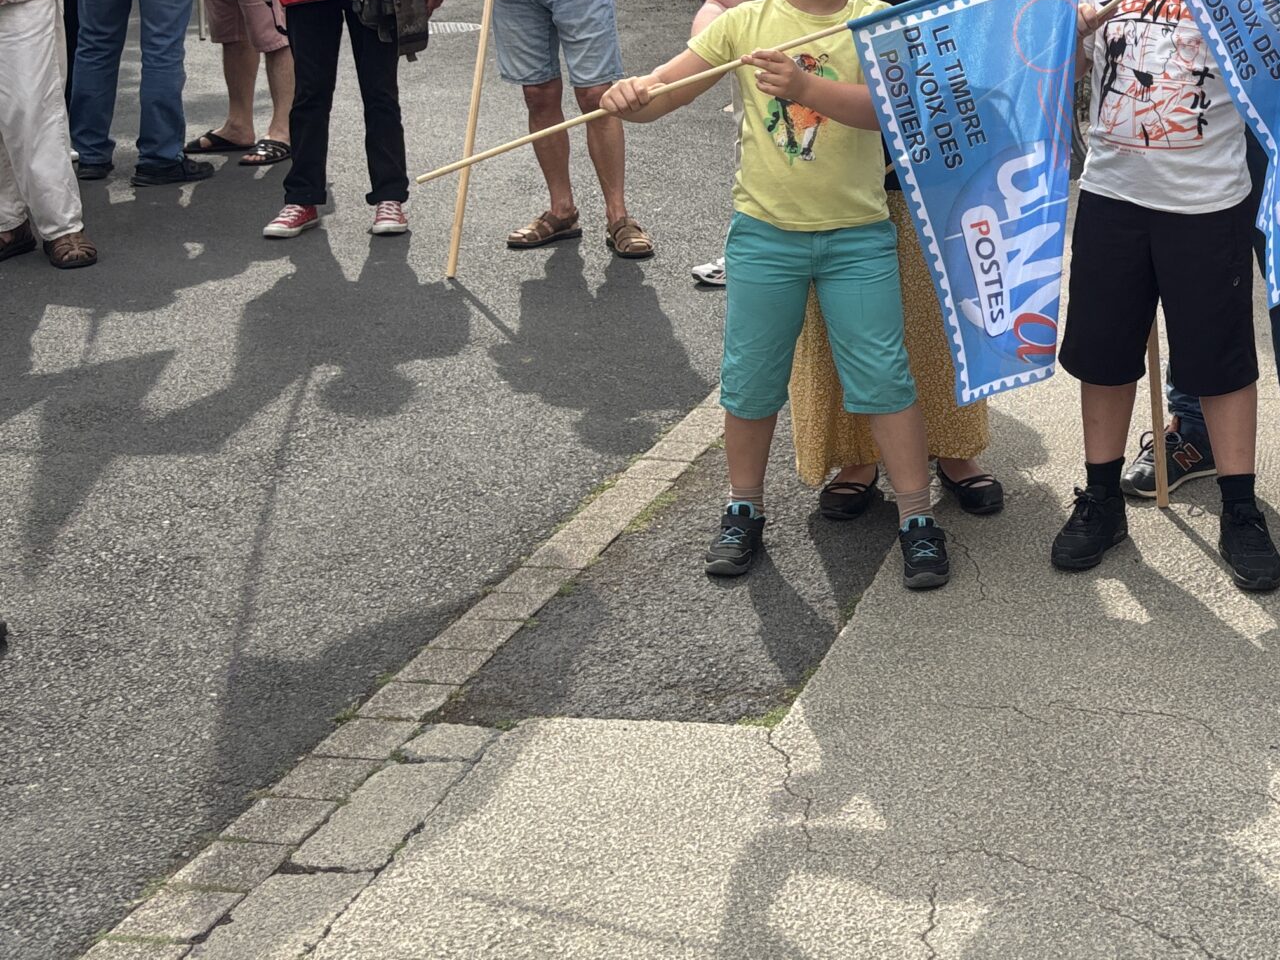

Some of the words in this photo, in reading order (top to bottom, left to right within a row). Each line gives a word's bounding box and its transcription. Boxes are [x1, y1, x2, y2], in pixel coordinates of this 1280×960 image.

[904, 26, 927, 59] DE
[932, 25, 957, 56] LE
[879, 49, 931, 165] POSTIERS
[915, 62, 947, 120] VOIX
[944, 58, 987, 147] TIMBRE
[933, 122, 964, 170] DES
[970, 219, 1004, 324] POSTES
